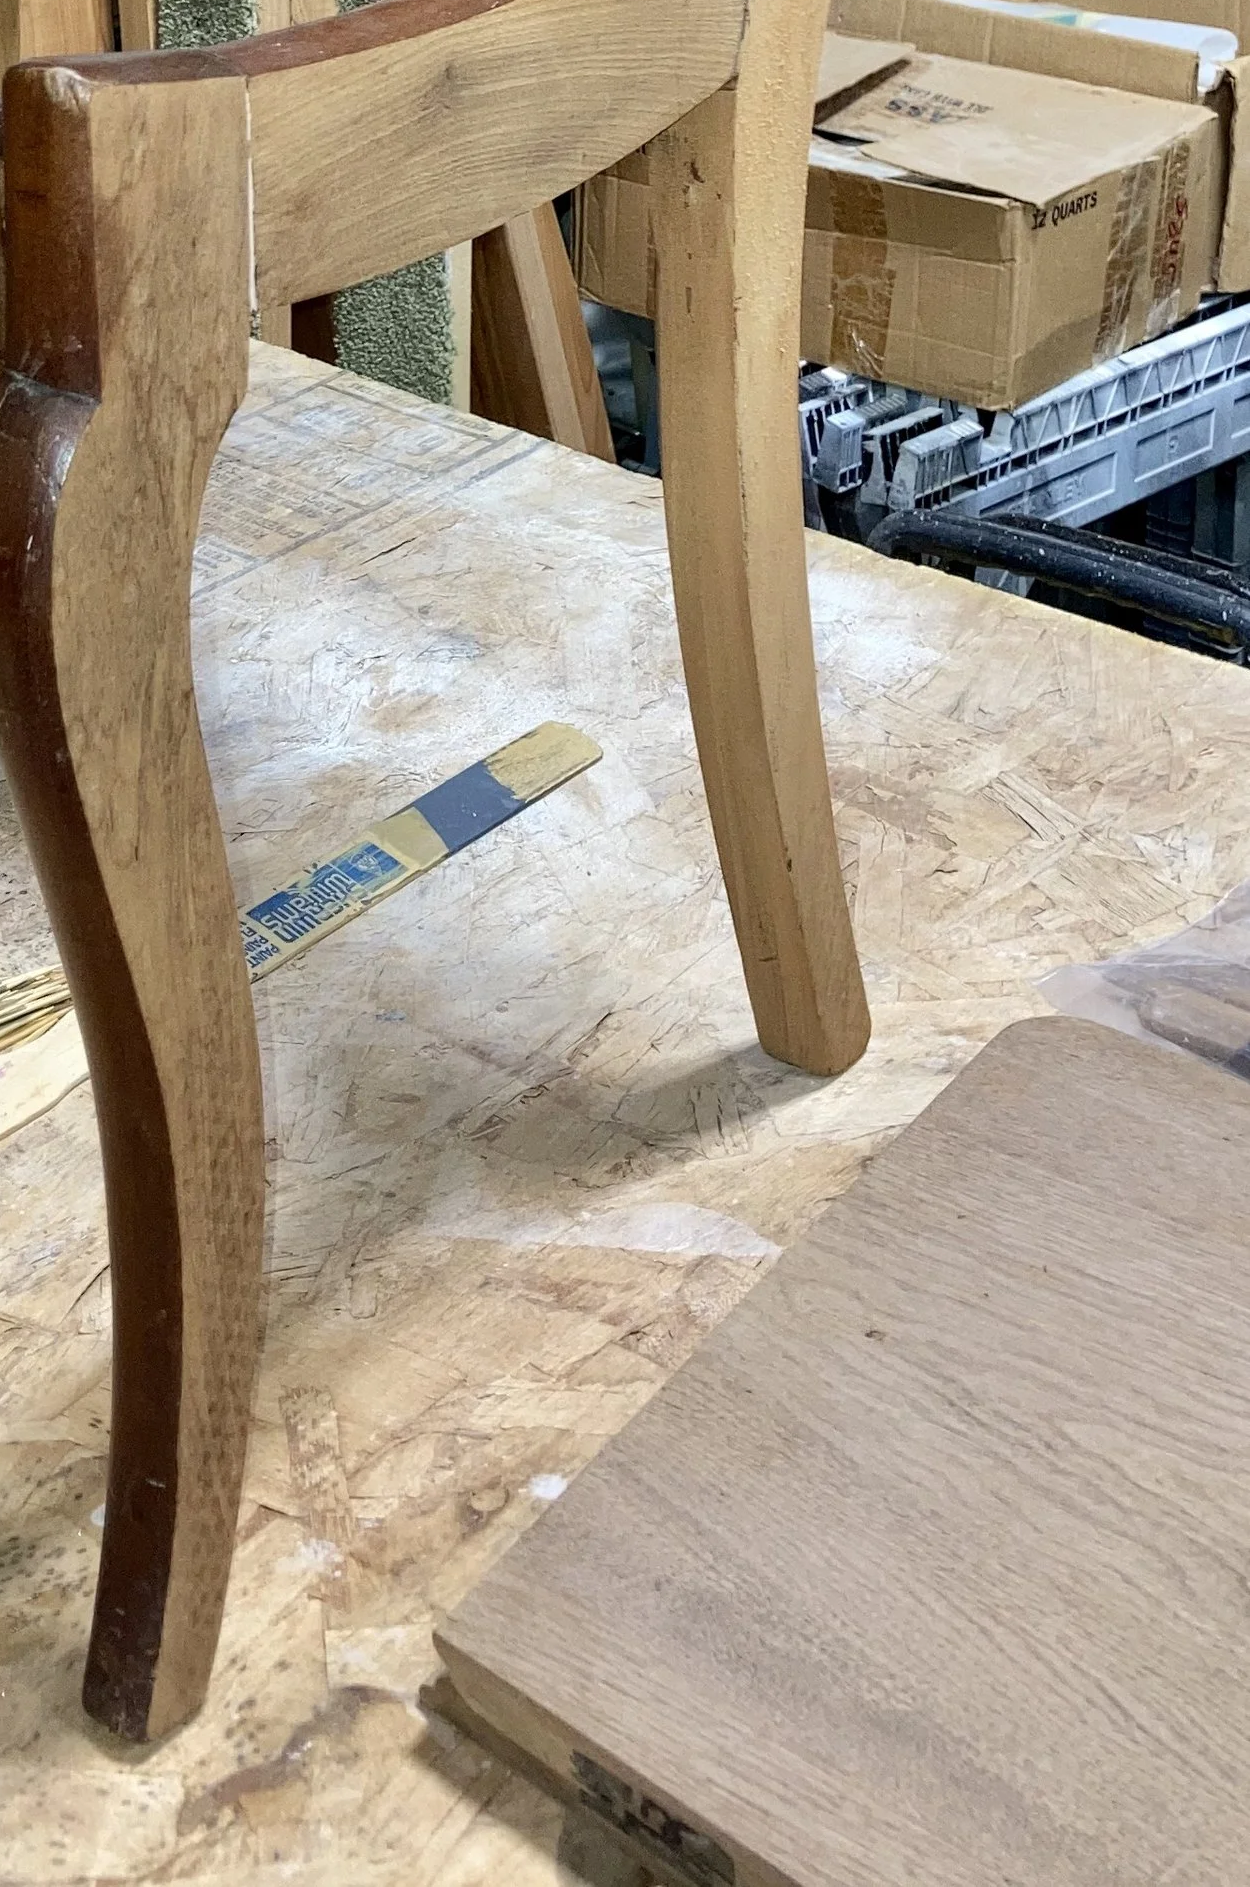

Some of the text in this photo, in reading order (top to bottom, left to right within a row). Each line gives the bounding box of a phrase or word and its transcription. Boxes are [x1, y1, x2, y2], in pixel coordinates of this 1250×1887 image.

[1052, 191, 1098, 226] QUARTS
[244, 935, 268, 955] PAIN
[247, 943, 279, 968] PAINT
